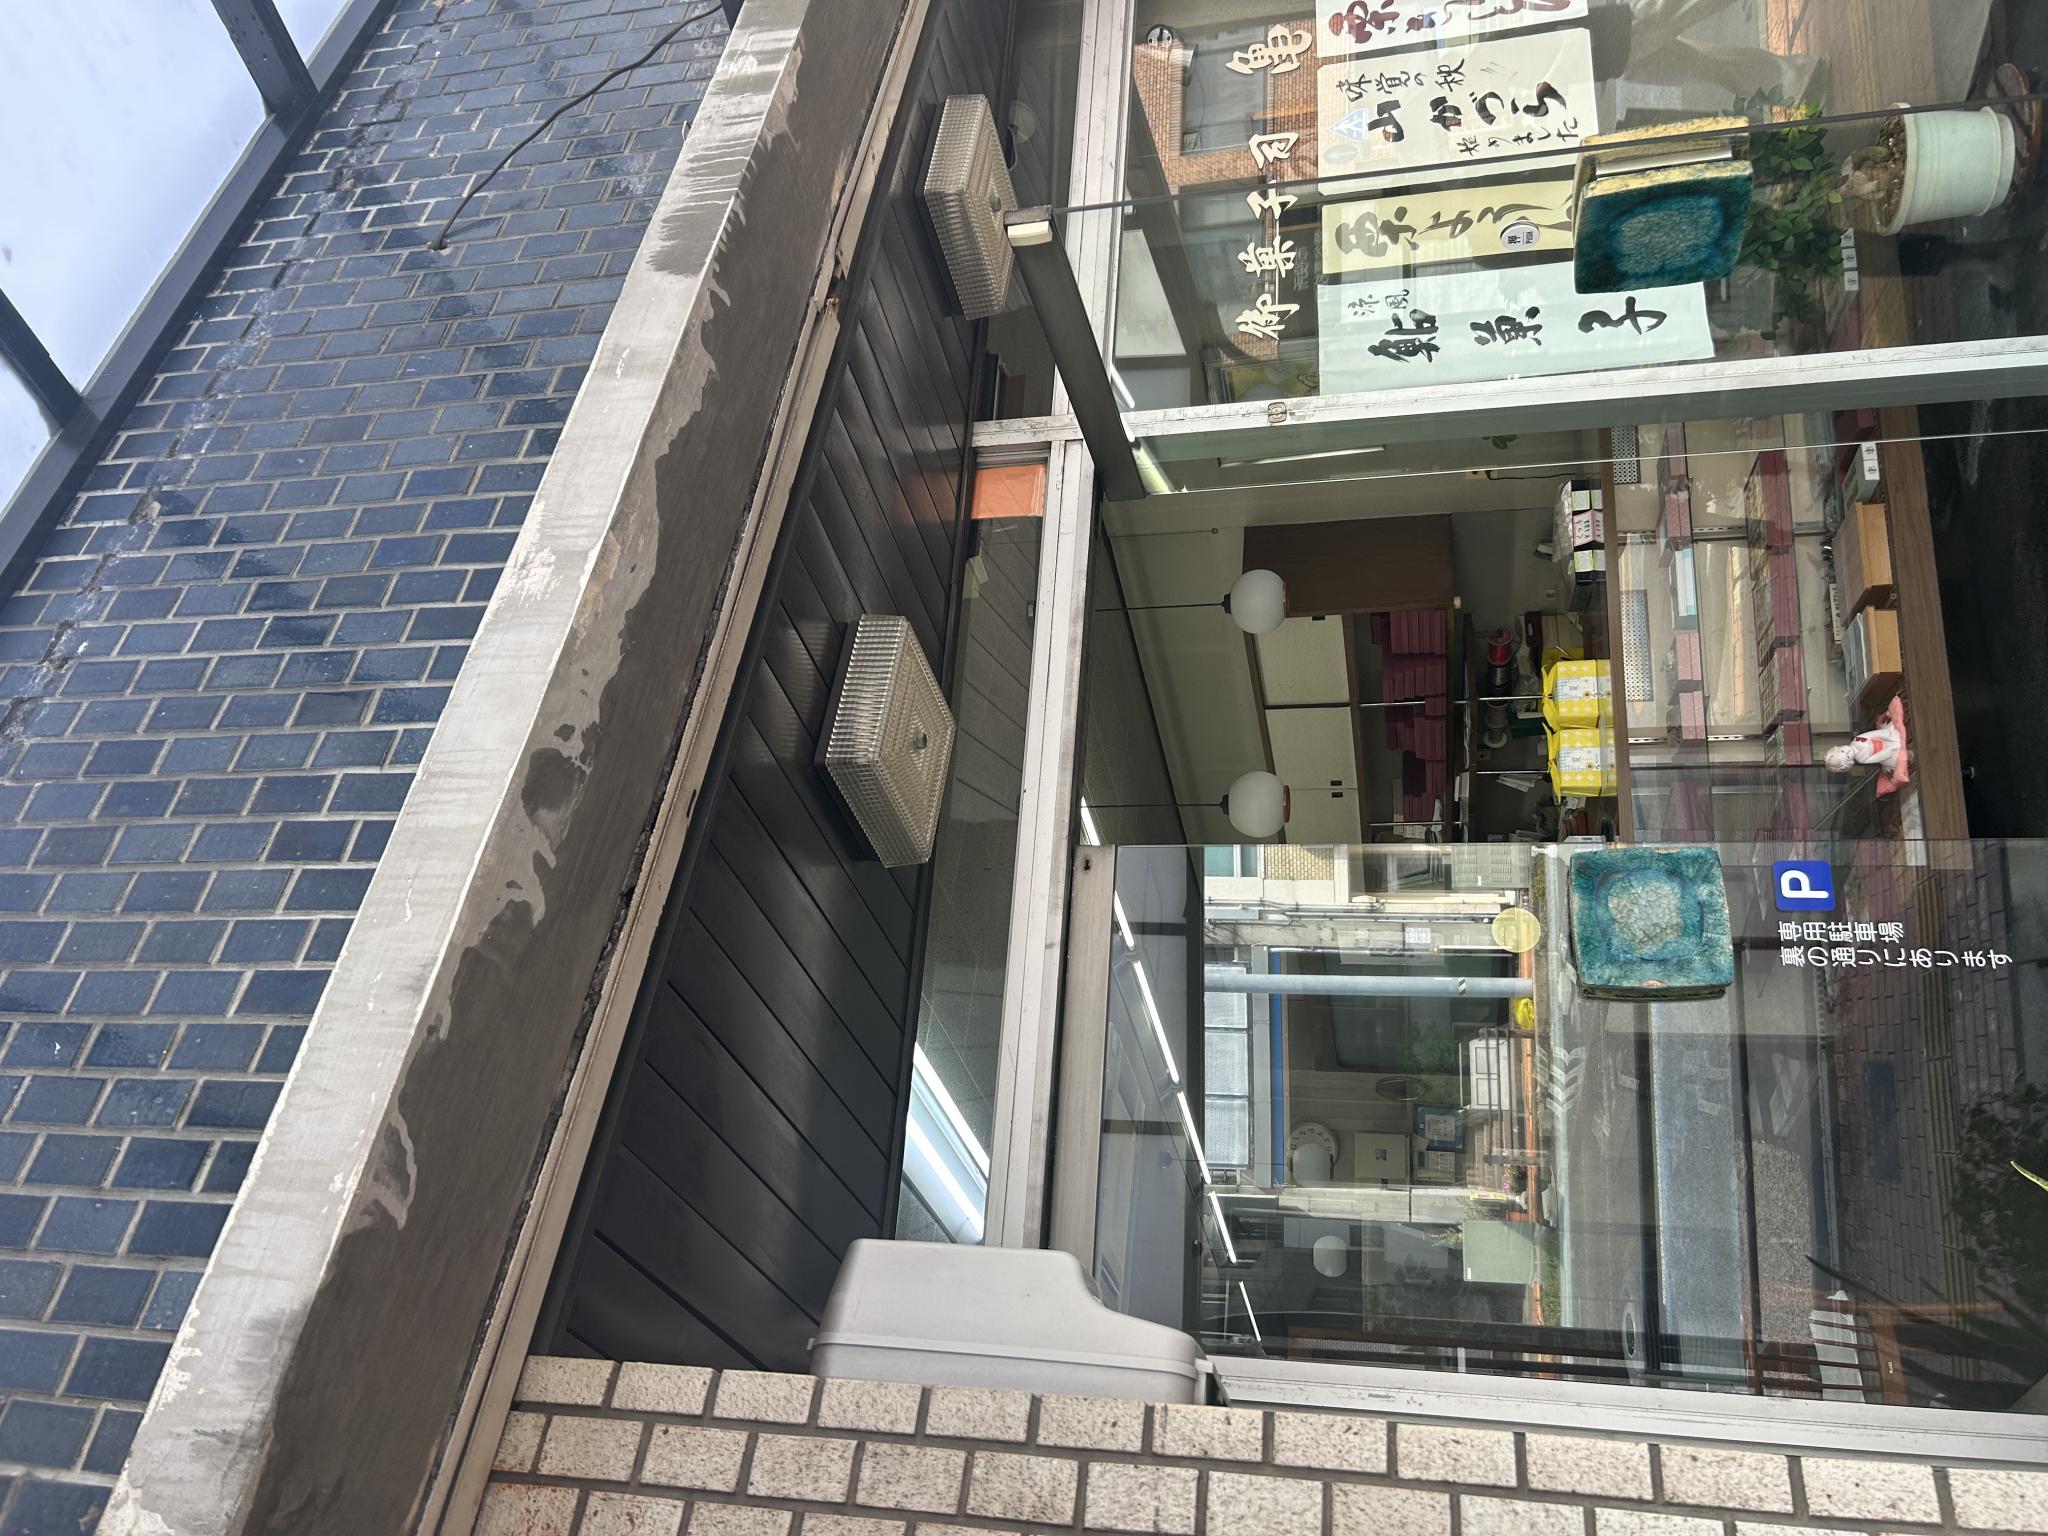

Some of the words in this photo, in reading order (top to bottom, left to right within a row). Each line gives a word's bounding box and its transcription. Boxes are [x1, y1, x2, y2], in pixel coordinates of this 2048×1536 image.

[1225, 24, 1312, 75] 亀
[1336, 58, 1465, 102] 味覚の秋
[1367, 81, 1567, 143] 山かづら
[1456, 116, 1579, 157] 始めました
[1235, 132, 1300, 340] 御菓子司
[1335, 194, 1572, 258] 栗よう
[1526, 231, 1534, 244] PUSH
[1347, 288, 1410, 317] 涼風
[1367, 295, 1667, 363] 鮎菓子
[1780, 869, 1829, 899] P
[1778, 920, 1904, 943] 専用駐車場
[1780, 946, 2013, 970] 裏の通りにあります
